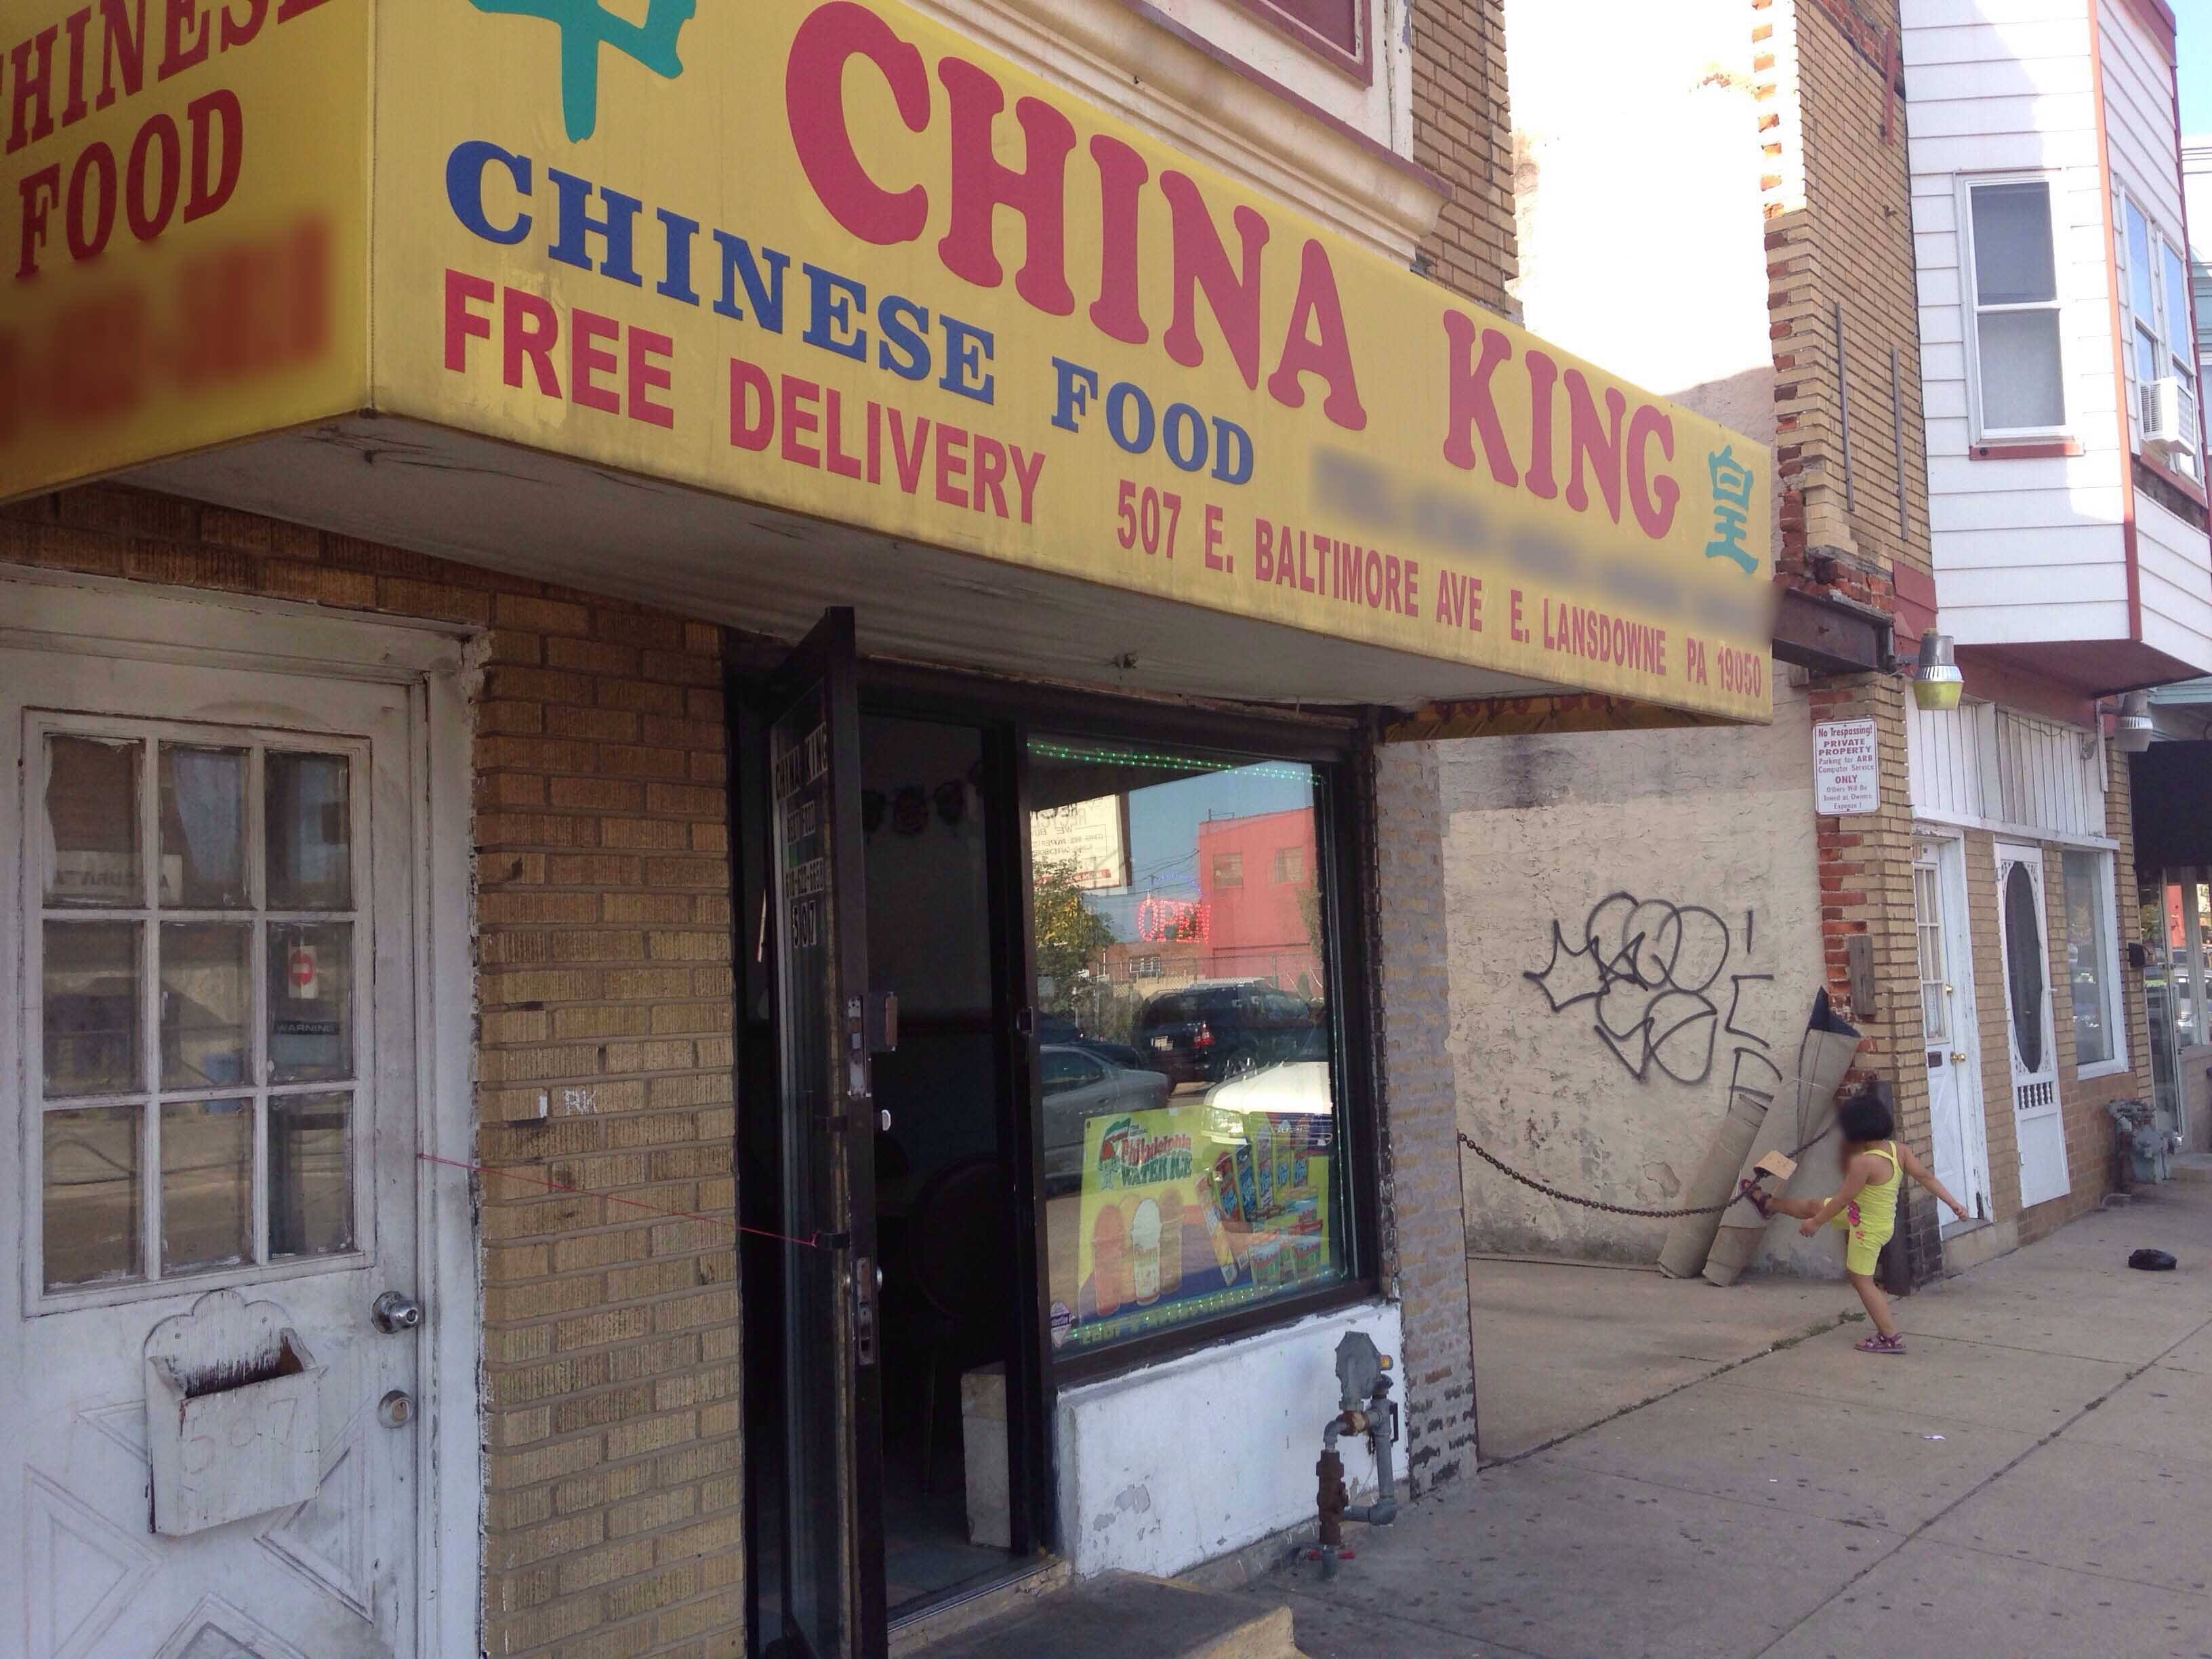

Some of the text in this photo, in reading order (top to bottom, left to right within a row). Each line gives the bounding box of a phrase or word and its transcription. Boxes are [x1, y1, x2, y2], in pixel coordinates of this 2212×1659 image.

[0, 0, 332, 155] HINES
[16, 89, 243, 280] FOOD
[786, 1, 1367, 430] CHINA
[1443, 309, 1680, 539] KING
[446, 140, 994, 405] CHINESE
[1052, 356, 1254, 485] FOOD
[445, 268, 674, 430] FREE
[731, 357, 1046, 525] DELIVERY
[1118, 479, 1181, 558] 507
[1205, 504, 1233, 573] E.
[1256, 518, 1418, 617] BALTIMORE
[1437, 570, 1482, 632] AVE
[1510, 588, 1529, 643] E.
[1544, 598, 1666, 675] LANSDOWNE
[1687, 637, 1707, 685] PA
[1718, 645, 1761, 697] 19050
[1818, 725, 1872, 738] No Trespassing!
[1819, 746, 1871, 756] PROPERTY
[1824, 738, 1865, 747] PRIVATE
[1818, 766, 1848, 774] Computer
[1819, 757, 1841, 765] Parking
[1835, 775, 1858, 784] ONLY
[792, 900, 816, 948] 507
[1138, 899, 1211, 943] OPEN
[1122, 1149, 1193, 1187] WATER ICE
